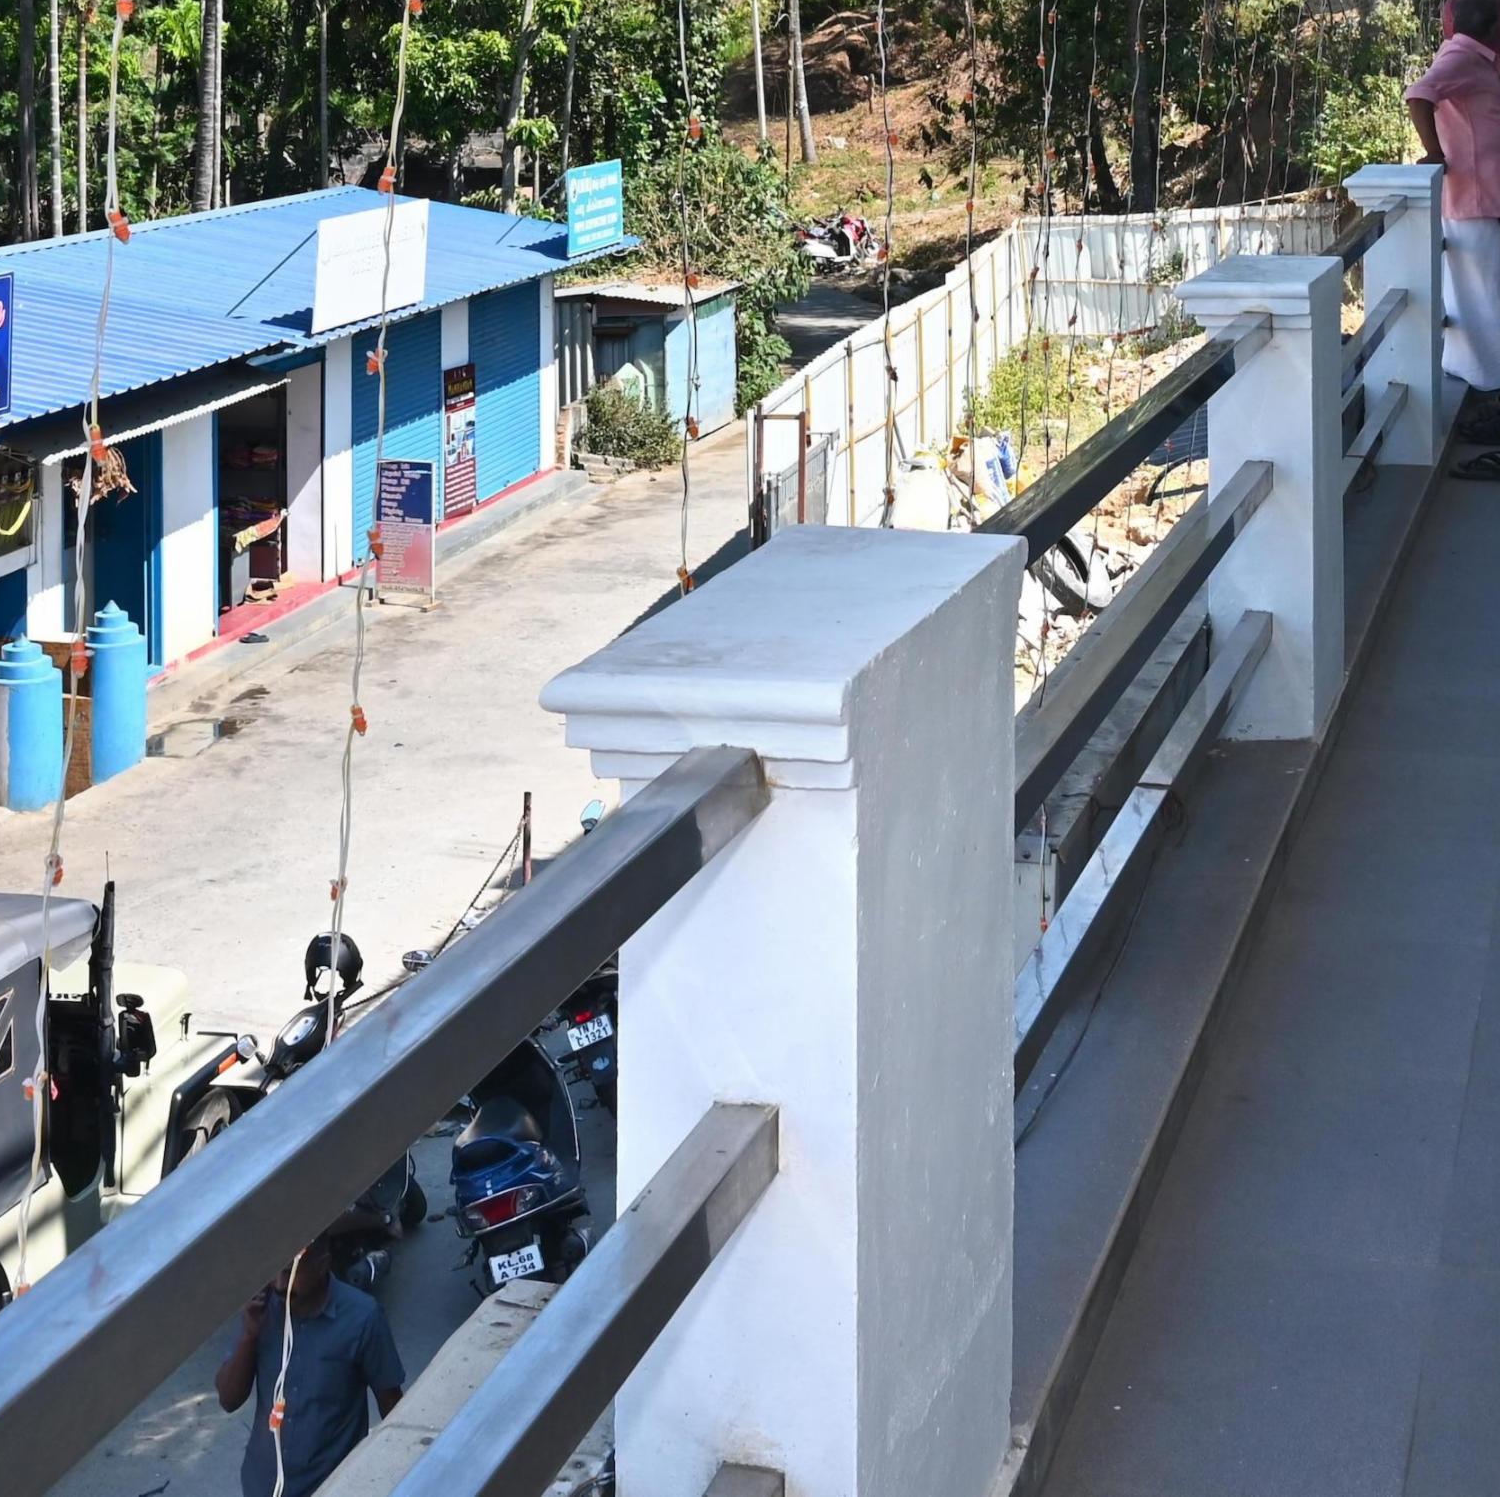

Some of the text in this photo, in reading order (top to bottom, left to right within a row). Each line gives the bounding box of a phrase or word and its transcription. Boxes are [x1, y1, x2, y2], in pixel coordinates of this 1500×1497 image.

[585, 1026, 609, 1044] 1321
[500, 1262, 536, 1280] A 734
